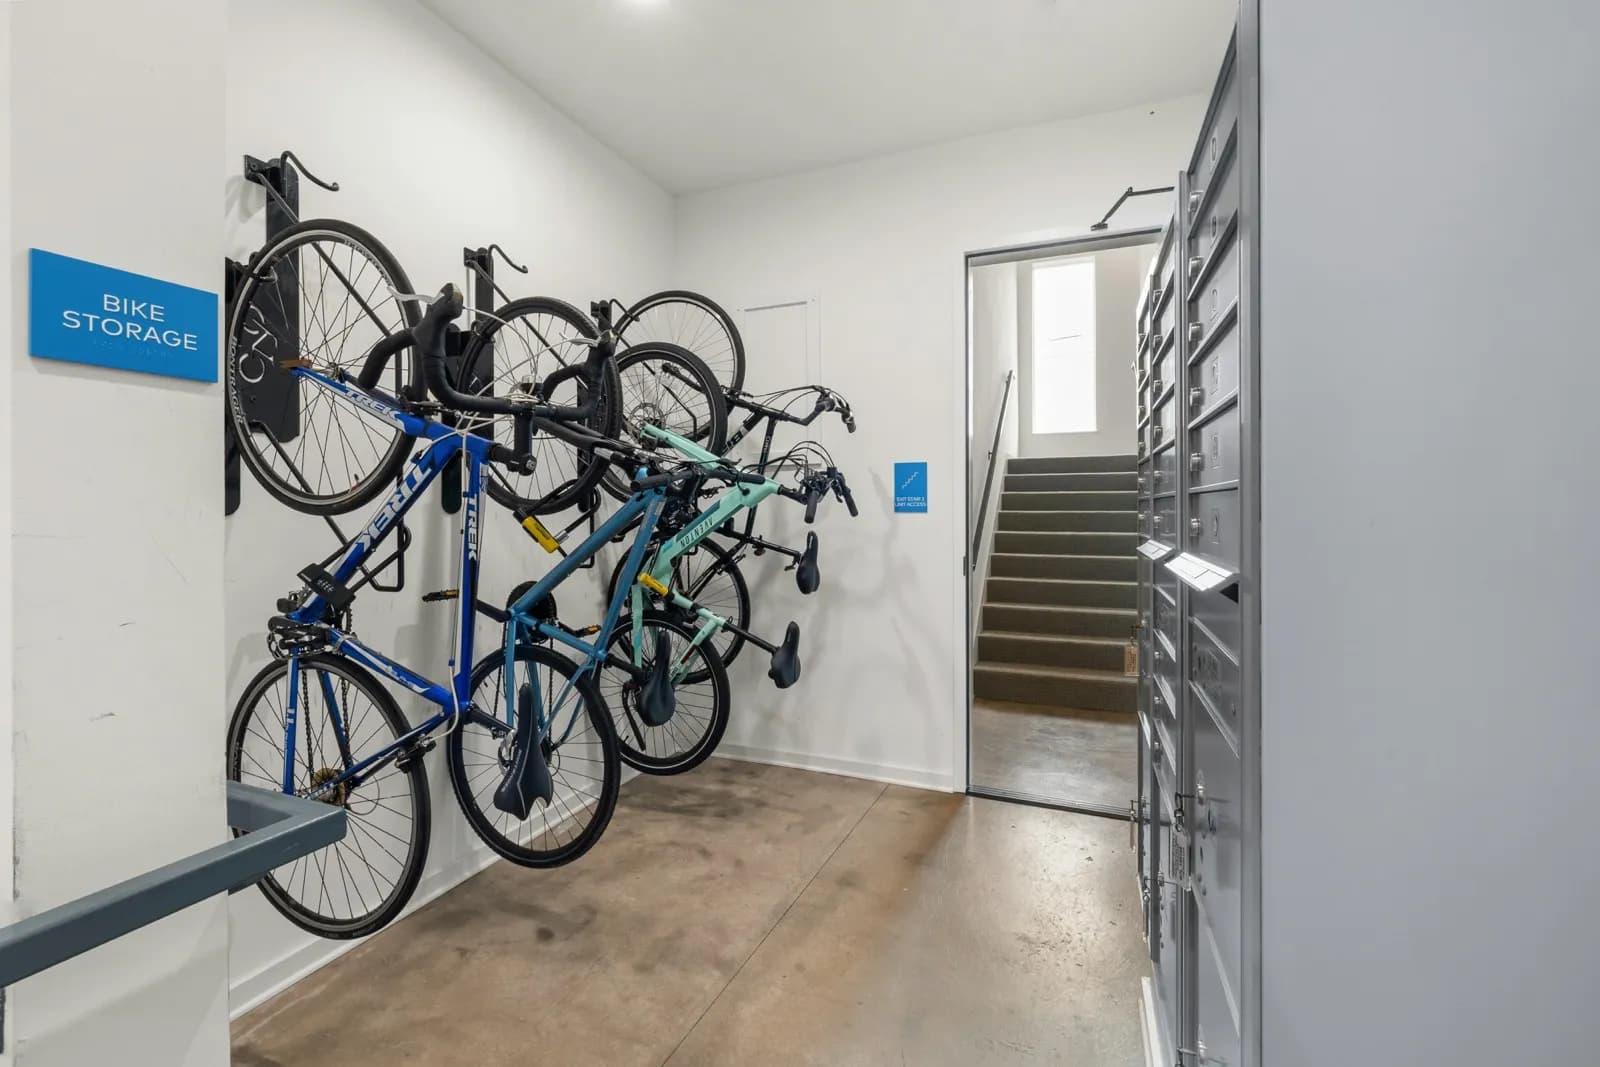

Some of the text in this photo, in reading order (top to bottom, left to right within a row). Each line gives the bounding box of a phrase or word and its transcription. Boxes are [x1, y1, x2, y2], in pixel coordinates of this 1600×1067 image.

[103, 293, 165, 322] BIKE
[62, 310, 198, 351] STORAGE
[230, 335, 244, 424] BONTRAGER
[345, 388, 401, 421] TREK
[355, 465, 432, 553] TREK
[468, 493, 478, 561] TREK
[680, 516, 713, 547] AVENTON
